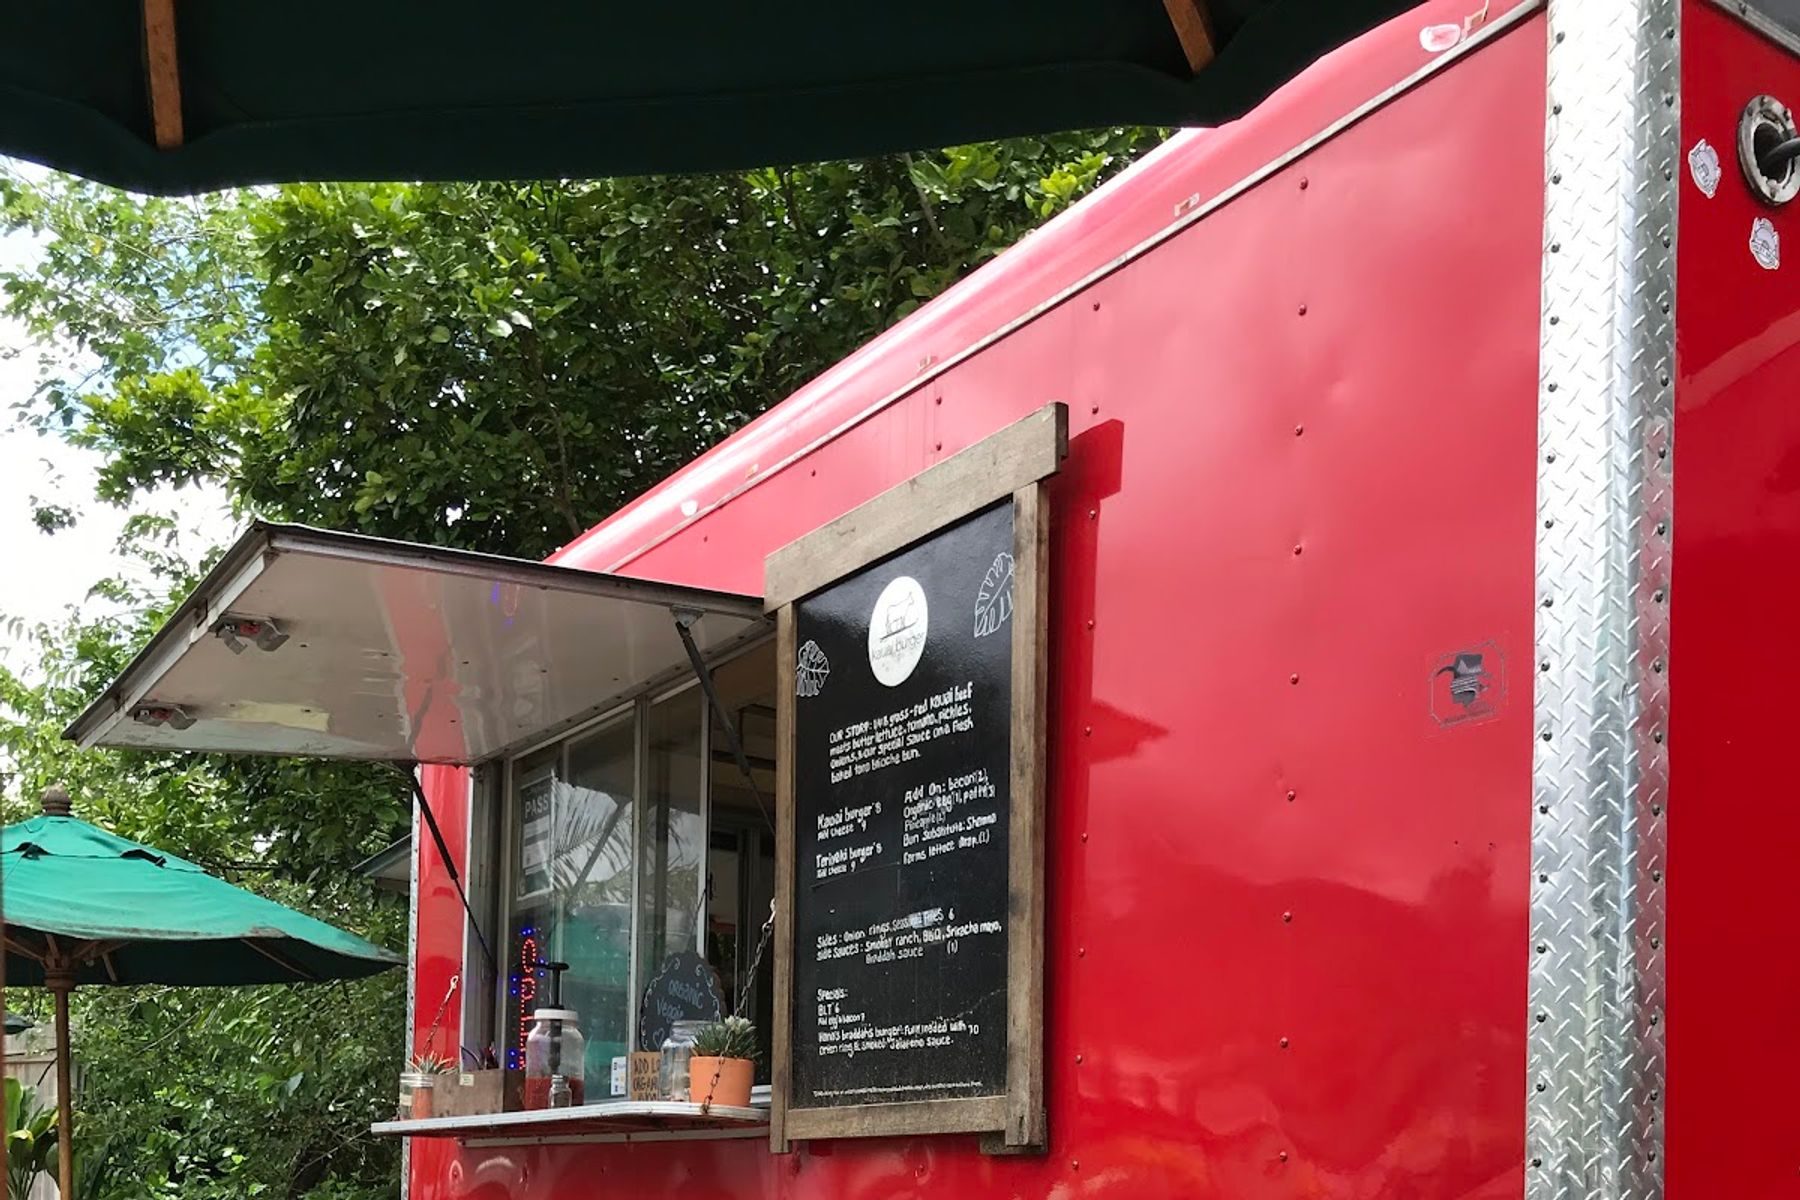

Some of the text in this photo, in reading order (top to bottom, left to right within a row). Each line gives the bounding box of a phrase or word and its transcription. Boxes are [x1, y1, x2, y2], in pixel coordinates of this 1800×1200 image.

[906, 729, 931, 746] sauce
[904, 785, 923, 803] Add
[525, 793, 549, 818] PASS
[844, 805, 872, 824] burger
[903, 833, 919, 847] Bun
[849, 844, 874, 863] burger
[897, 946, 923, 959] sauce
[818, 1003, 832, 1017] BLT
